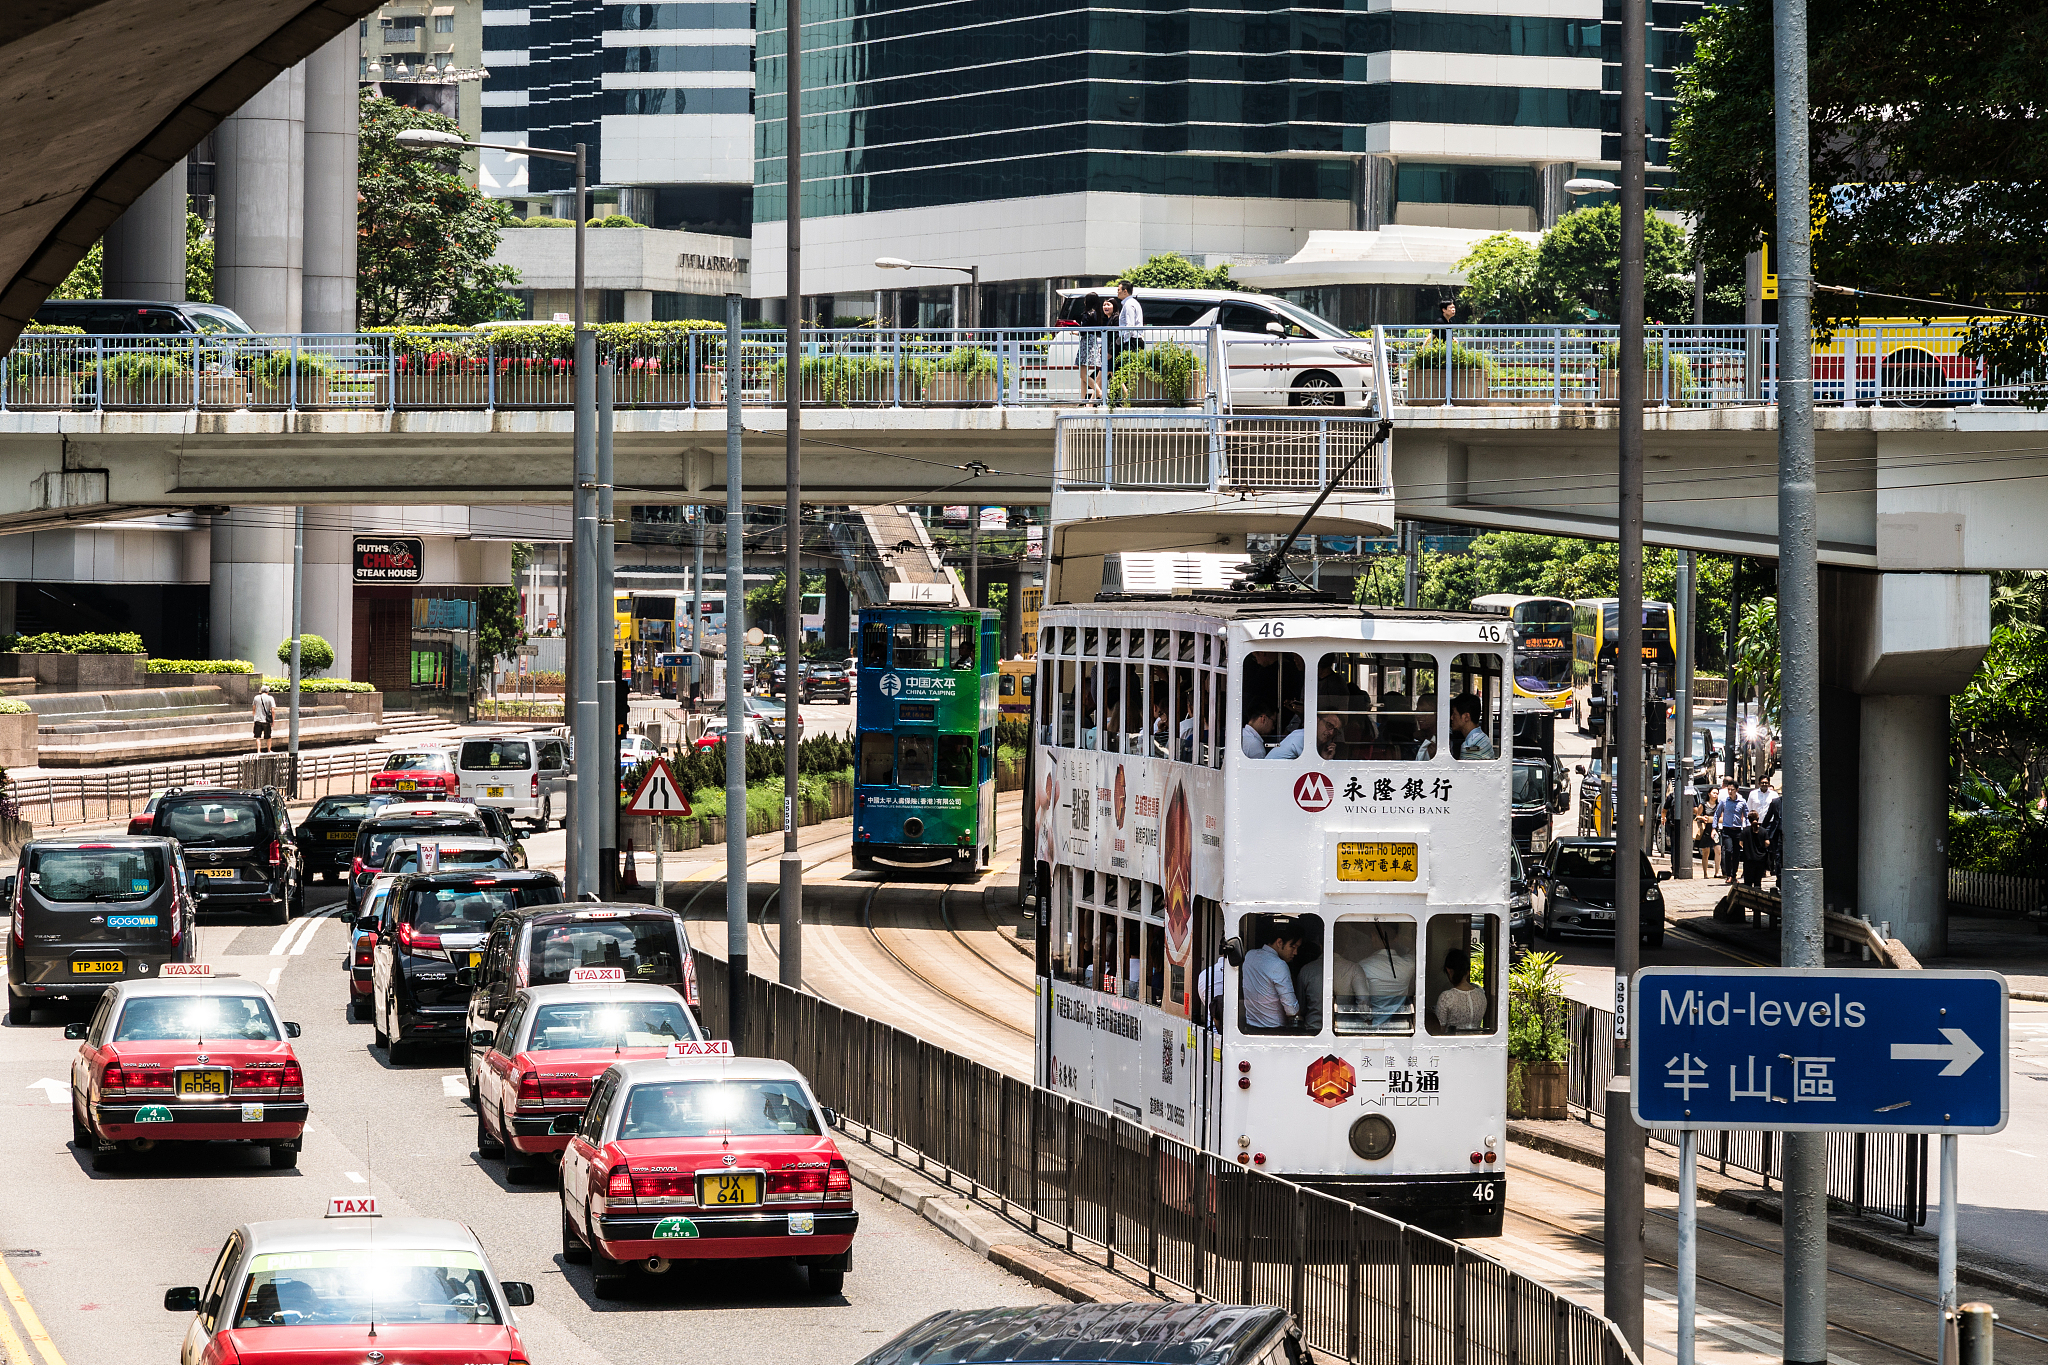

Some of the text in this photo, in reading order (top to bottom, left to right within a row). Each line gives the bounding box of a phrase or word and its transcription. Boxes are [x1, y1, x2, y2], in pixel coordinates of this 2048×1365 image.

[680, 253, 749, 274] JW MARRIOTT
[357, 544, 389, 553] RUTH'S
[363, 553, 414, 569] CHRIS
[357, 569, 417, 578] STEAK HOUSE
[911, 586, 933, 600] 114
[867, 613, 882, 621] 114
[962, 616, 974, 624] 114
[1258, 622, 1285, 638] 46
[1478, 625, 1500, 642] 46
[1548, 638, 1564, 648] 37A
[905, 677, 956, 689] 中国太平
[1342, 776, 1453, 801] 永隆銀行
[1062, 788, 1090, 832] 一點通
[1344, 805, 1451, 815] WING LUNG BANK
[957, 848, 970, 858] 114
[1341, 843, 1415, 858] Sai Wan Ho Depot
[425, 853, 433, 867] 的士
[1341, 858, 1415, 873] 西灣河電車廠
[109, 917, 156, 926] GOGOVAN
[1594, 912, 1605, 920] RJ
[77, 963, 119, 971] TP 3102
[165, 965, 210, 974] TAXI
[575, 970, 621, 980] TAXI
[1617, 982, 1625, 1036] 35604
[1659, 989, 1866, 1028] Mid-levels
[675, 1042, 727, 1054] TAXI
[1361, 1055, 1440, 1068] 永隆銀行
[193, 1073, 211, 1083] PC
[1361, 1070, 1440, 1093] 一點通
[1664, 1052, 1837, 1103] 半山區
[184, 1083, 221, 1093] 6088
[150, 1109, 158, 1117] 4
[719, 1176, 741, 1189] UX
[717, 1190, 744, 1203] 641
[1472, 1183, 1495, 1202] 46
[333, 1200, 375, 1213] TAXI
[671, 1222, 681, 1232] 4
[268, 1254, 312, 1270] POAD
